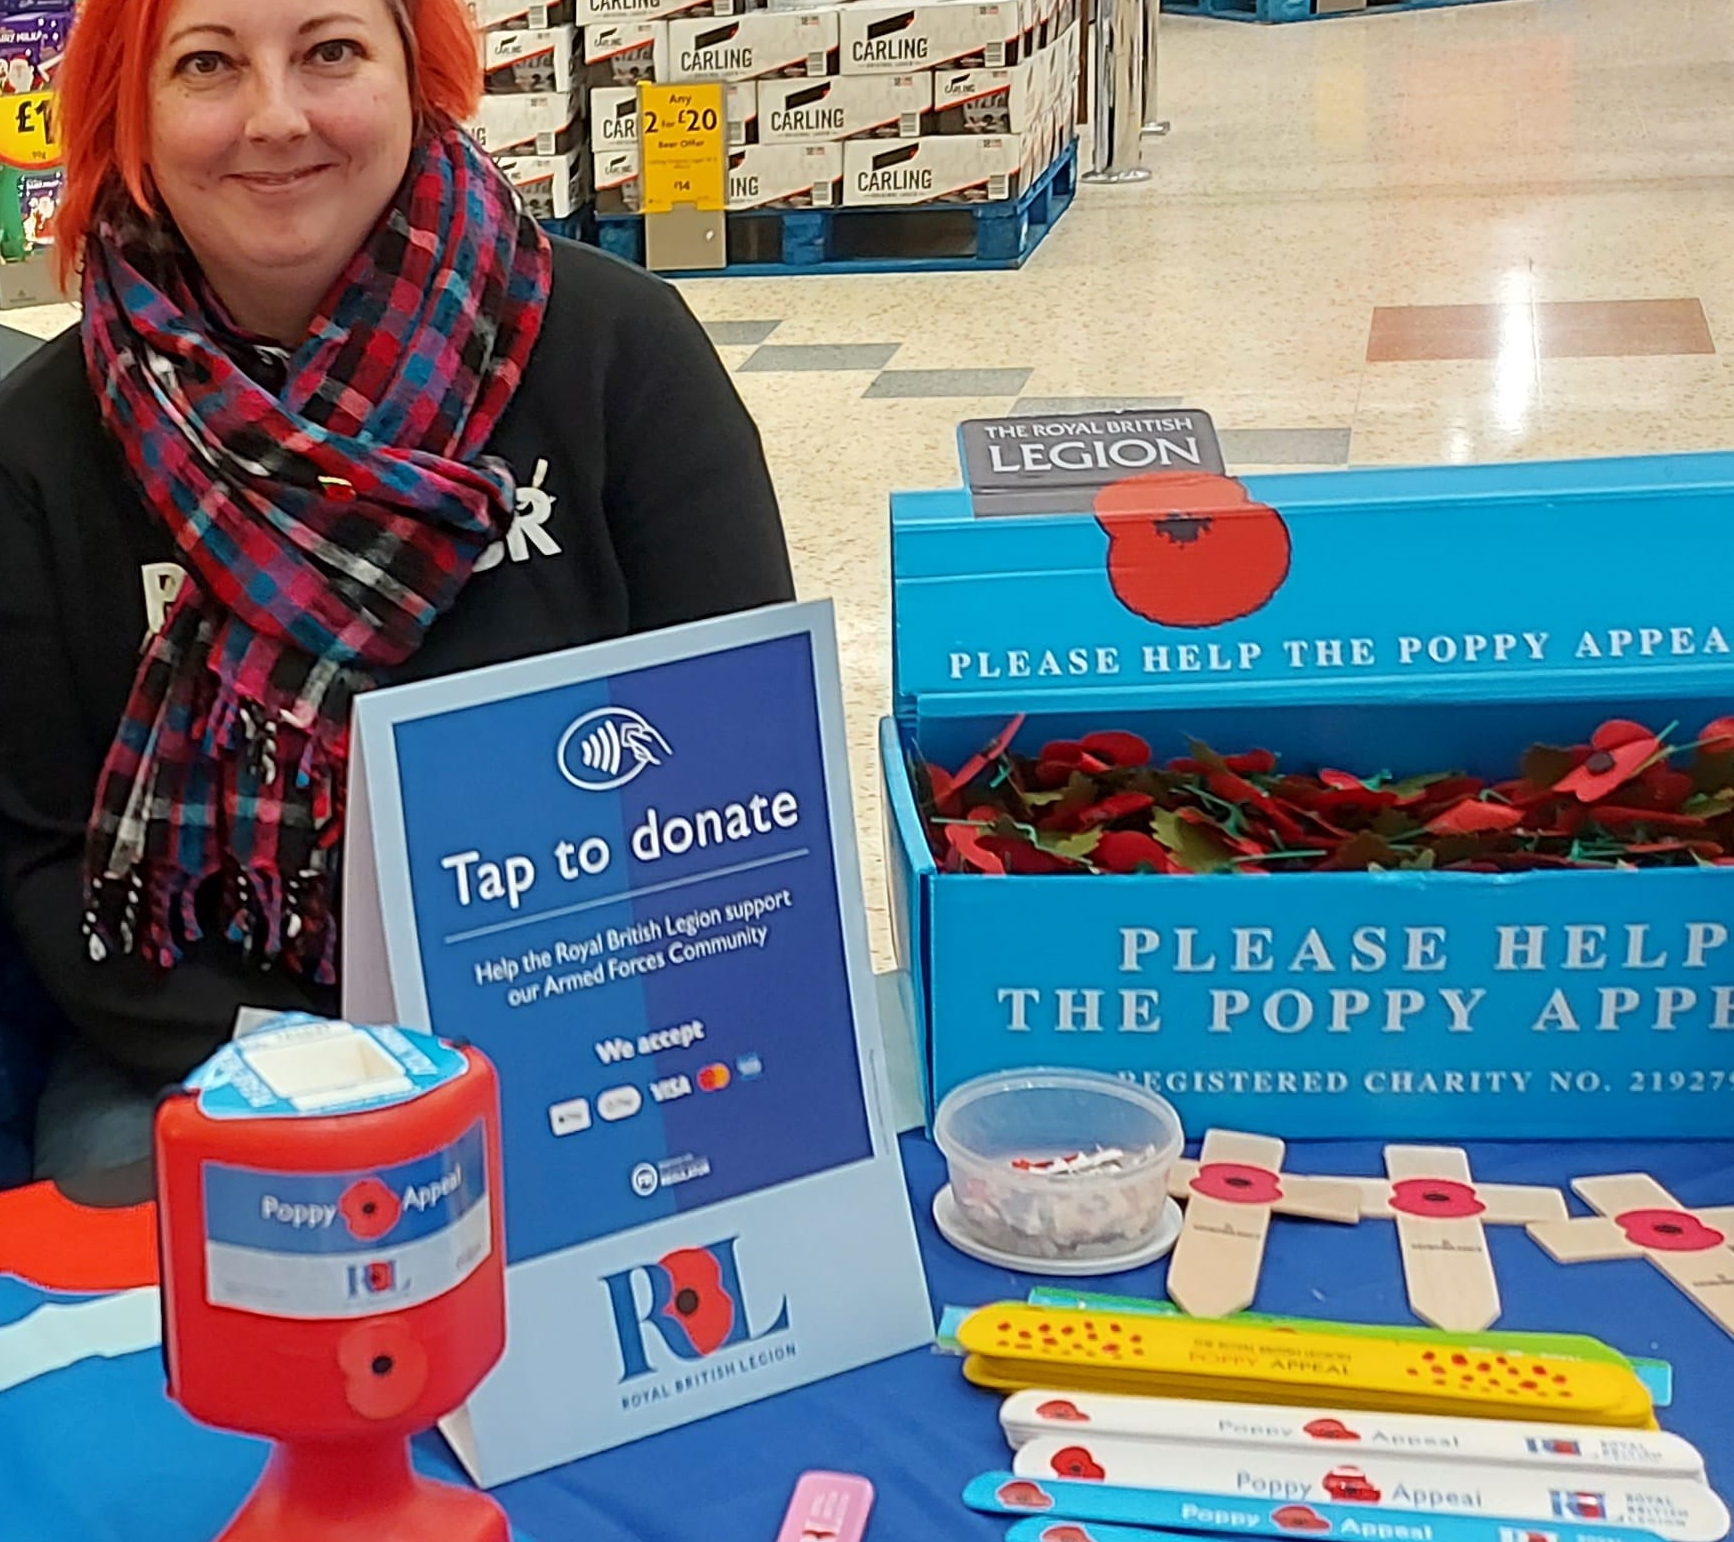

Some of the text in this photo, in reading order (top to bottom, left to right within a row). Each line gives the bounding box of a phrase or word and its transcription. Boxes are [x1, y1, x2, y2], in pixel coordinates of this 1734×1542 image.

[852, 37, 928, 63] CARLING
[669, 93, 693, 108] Any
[16, 99, 56, 144] £1
[644, 111, 659, 134] 2
[678, 108, 718, 132] £20
[771, 108, 845, 133] CARLING
[857, 170, 932, 193] CARLING
[985, 416, 1194, 440] THE ROYAL BRITISH
[987, 435, 1201, 473] LEGION
[949, 625, 1731, 680] PLEASE HELP THE POPPY APPEA
[440, 789, 800, 911] Tap to donate
[474, 889, 793, 988] Help the Royal British Legion support
[1118, 921, 1730, 973] PLEASE HELP
[507, 925, 769, 1009] our Armed Forces Community
[997, 986, 1166, 1035] THE
[1208, 986, 1489, 1035] POPPY
[593, 1019, 706, 1066] We accept
[648, 1074, 693, 1104] VISA
[1363, 1068, 1534, 1095] CHARITY
[1547, 1068, 1613, 1095] NO.
[260, 1163, 463, 1229] Poppy Appeal
[621, 1343, 798, 1412] ROYAL BRITISH LEGION
[1235, 1471, 1483, 1509] Poppy Appeal
[1180, 1503, 1433, 1542] Poppy Appeal
